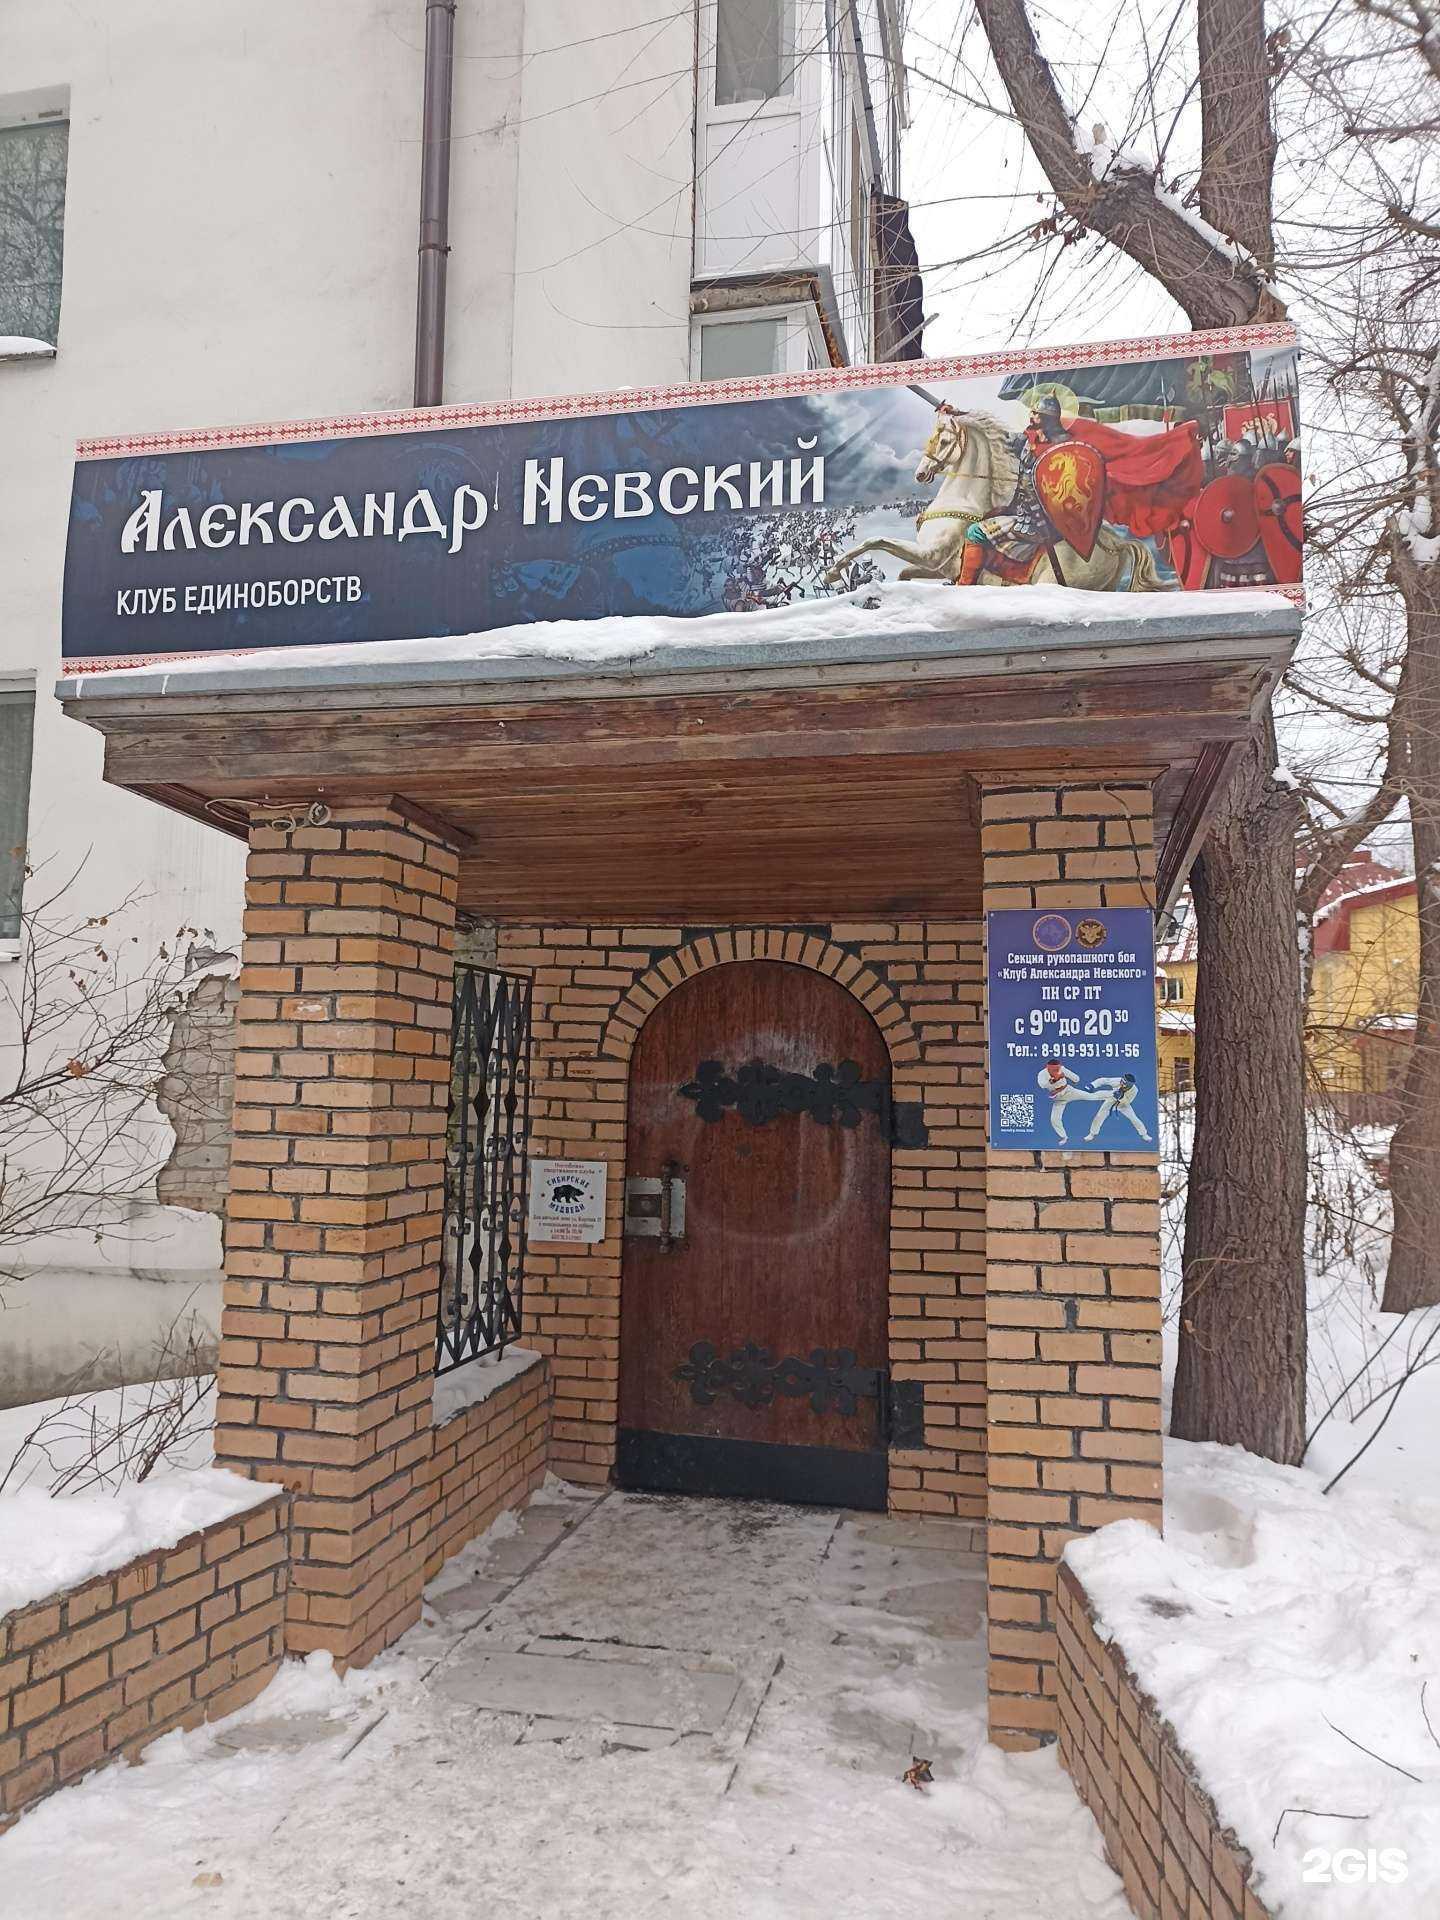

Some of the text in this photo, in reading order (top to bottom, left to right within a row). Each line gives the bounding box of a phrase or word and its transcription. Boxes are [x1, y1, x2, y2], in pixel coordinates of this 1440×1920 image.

[121, 435, 826, 554] Александр Невский
[117, 575, 362, 616] КЛУБ ЕДИНОБОРСТВ
[1007, 951, 1136, 967] Секция рукопашного боя
[998, 967, 1027, 982] «Клуб
[1030, 967, 1091, 981] Александра
[1041, 985, 1102, 1000] ПН СР ПТ
[1058, 1018, 1081, 1037] до
[1007, 1042, 1140, 1058] Тел.: 8-919-931-91-56
[549, 1201, 586, 1214] МЕДВЕДИ
